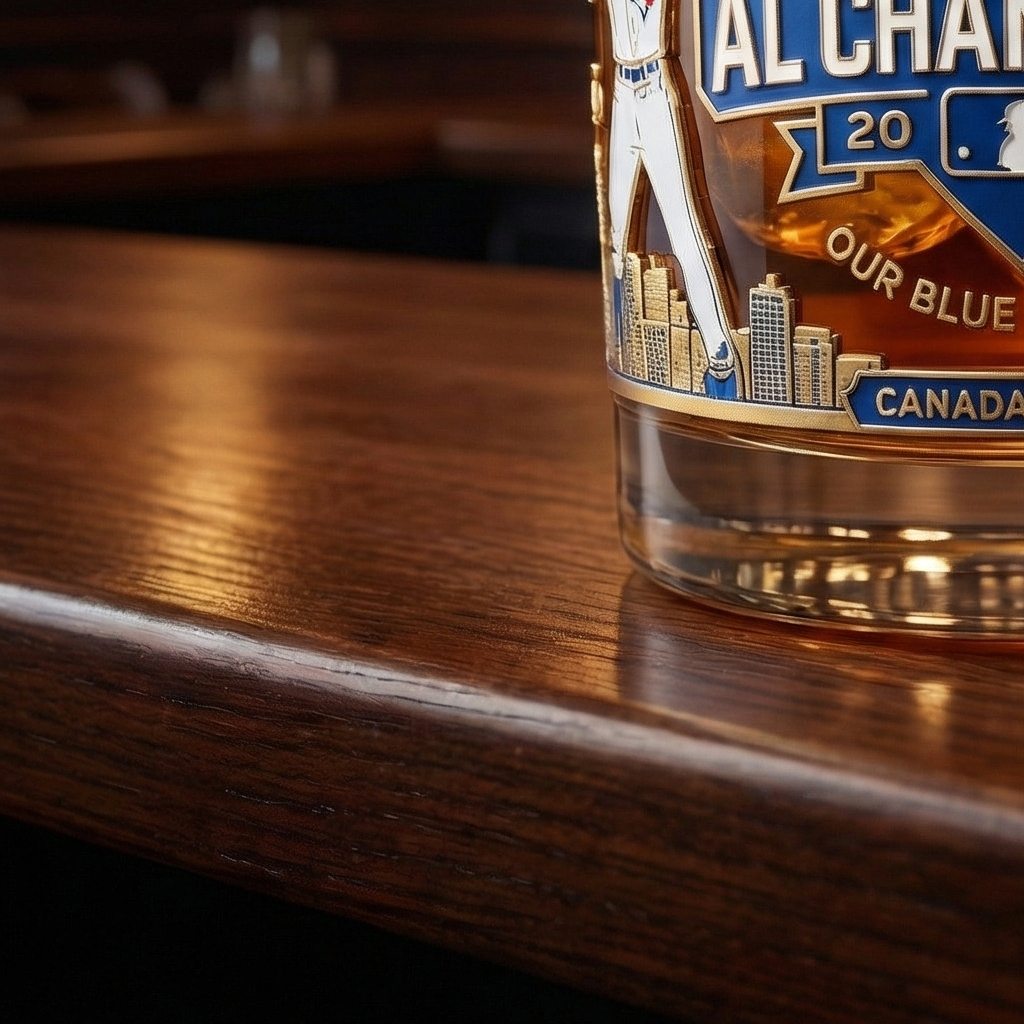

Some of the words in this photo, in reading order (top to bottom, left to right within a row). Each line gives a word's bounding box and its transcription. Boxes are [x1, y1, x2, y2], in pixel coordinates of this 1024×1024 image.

[846, 109, 912, 150] 20
[826, 225, 904, 301] OUR
[908, 277, 1017, 333] BLUE
